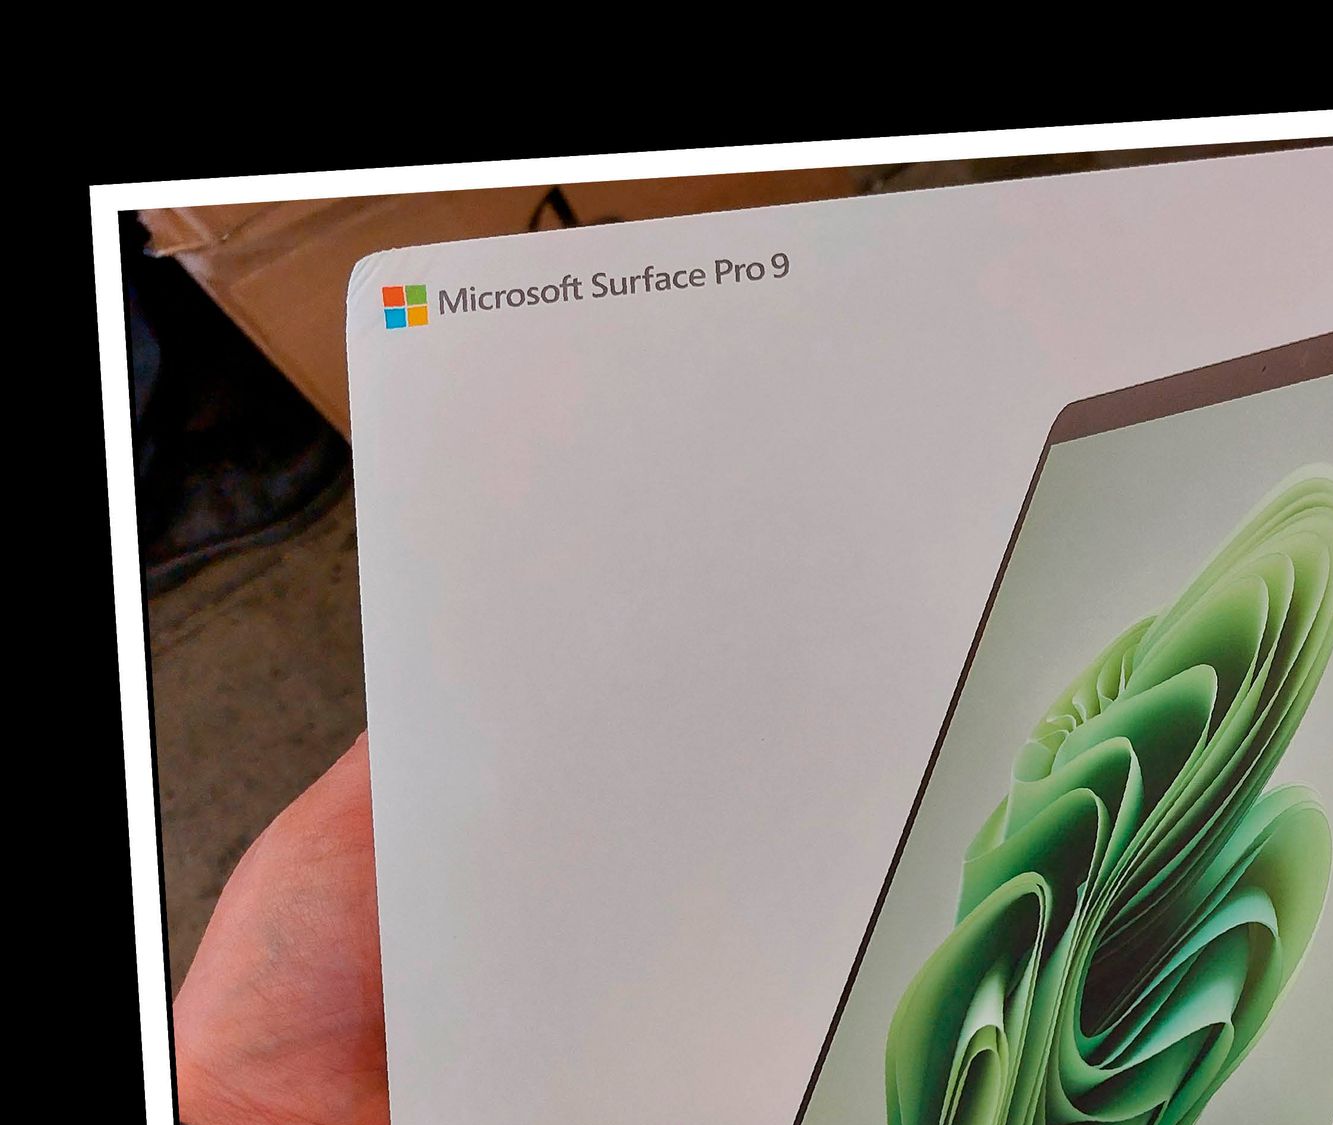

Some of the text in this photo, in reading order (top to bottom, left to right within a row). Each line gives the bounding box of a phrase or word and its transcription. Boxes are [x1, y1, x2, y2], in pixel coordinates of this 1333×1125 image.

[438, 252, 791, 316] Microsoft Surface Pro 9
